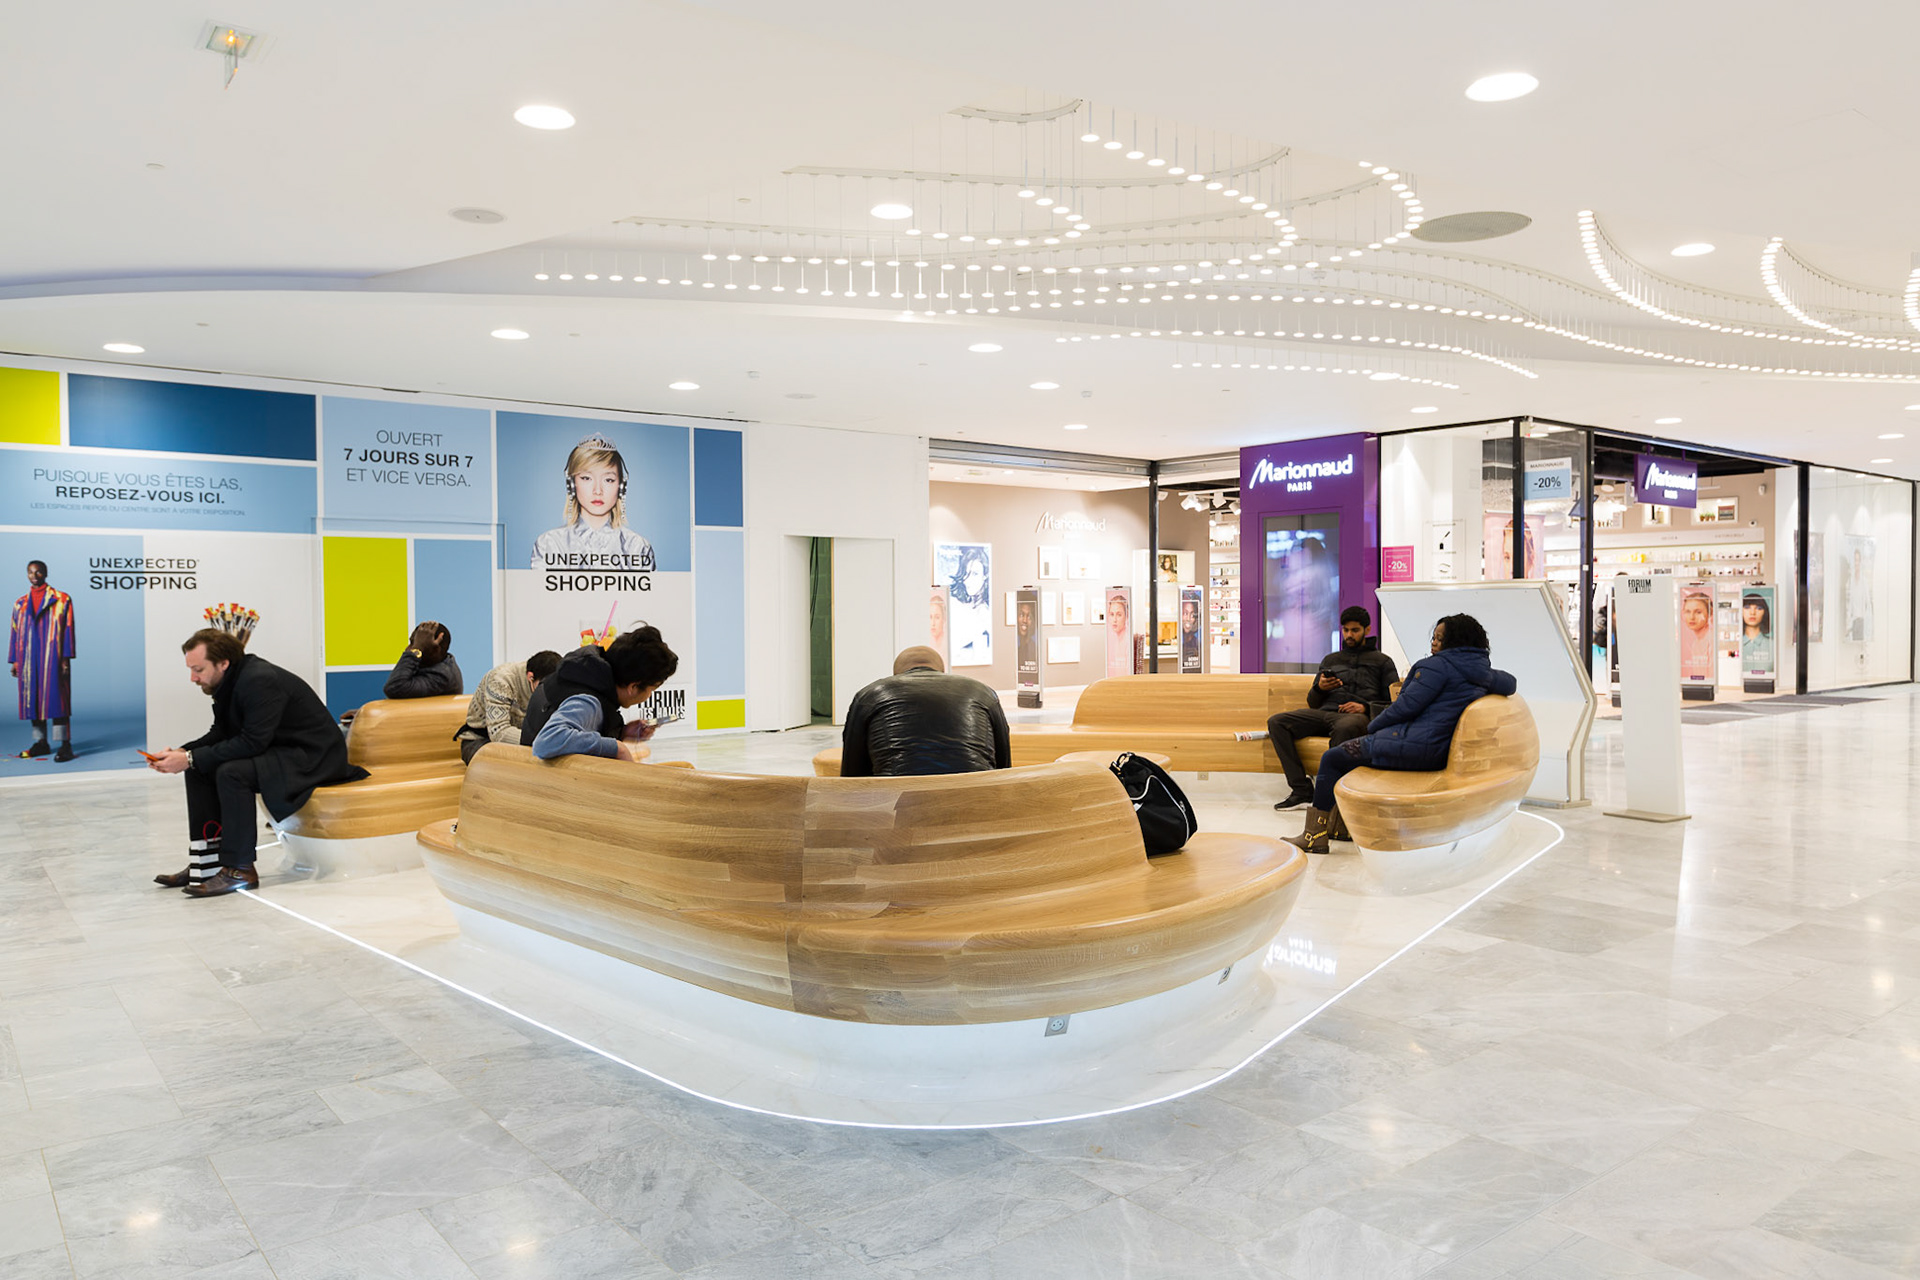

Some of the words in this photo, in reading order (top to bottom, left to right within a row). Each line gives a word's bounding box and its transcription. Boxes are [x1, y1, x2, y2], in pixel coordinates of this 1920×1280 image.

[376, 429, 443, 447] OUVERT
[344, 448, 353, 461] 7
[359, 449, 420, 466] JOURS
[424, 453, 460, 468] SUR
[464, 456, 474, 468] 7
[33, 468, 110, 484] PUISQUE
[114, 472, 160, 487] VOUS
[165, 472, 205, 489] ÊTES
[209, 477, 243, 492] LAS,
[346, 467, 368, 482] ET
[371, 469, 410, 485] VICE
[414, 472, 472, 488] VERSA.
[1248, 453, 1354, 490] Marionnaud
[1286, 480, 1313, 493] PARIS
[1533, 475, 1562, 489] -20%
[55, 485, 194, 503] REPOSEZ-VOUS
[199, 491, 226, 504] ICI.
[89, 557, 197, 569] UNEXPECTED
[545, 552, 651, 567] UNEXPECTED
[89, 575, 198, 590] SHOPPING
[545, 574, 652, 592] SHOPPING
[1627, 578, 1652, 588] FORUM
[637, 689, 685, 708] RUM
